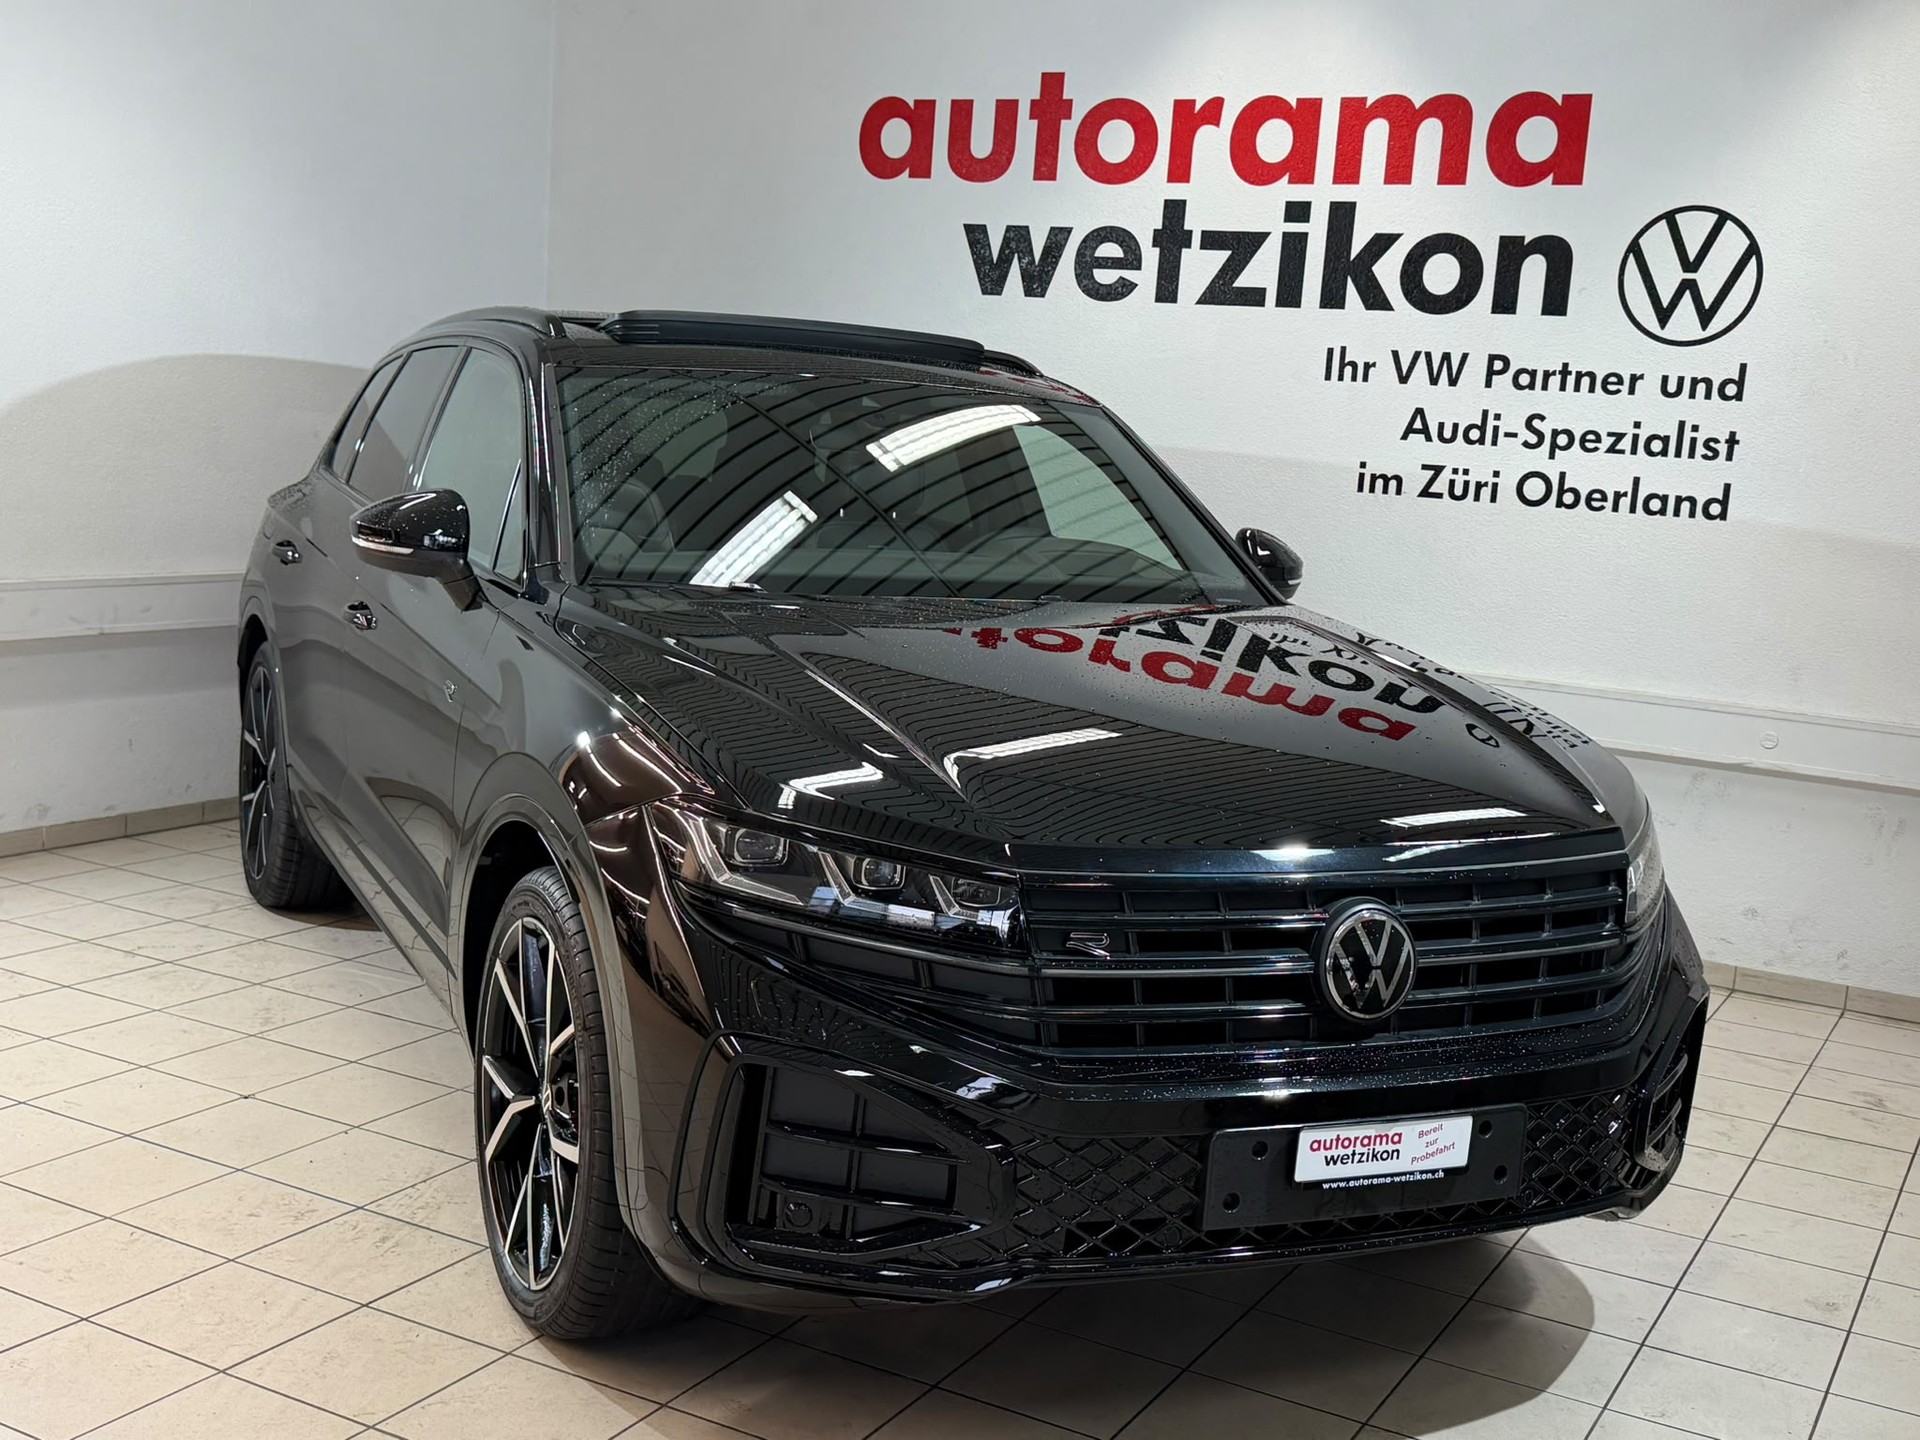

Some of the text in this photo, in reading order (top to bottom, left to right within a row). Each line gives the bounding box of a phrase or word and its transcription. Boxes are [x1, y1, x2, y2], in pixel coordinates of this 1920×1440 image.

[859, 72, 1592, 187] autorama
[963, 200, 1573, 316] wetzikon
[1325, 346, 1747, 401] Ihr VW Partner und
[1401, 408, 1740, 461] Audi-Spezialist
[1357, 462, 1731, 520] im Züri Oberland
[1309, 1132, 1403, 1152] autorama
[1418, 1123, 1443, 1139] Bereit
[1411, 1142, 1455, 1165] Probefahrt
[1425, 1138, 1439, 1148] zur
[1324, 1148, 1401, 1167] wetzikon
[1322, 1170, 1444, 1189] www.autorama-wetzikon.ch
